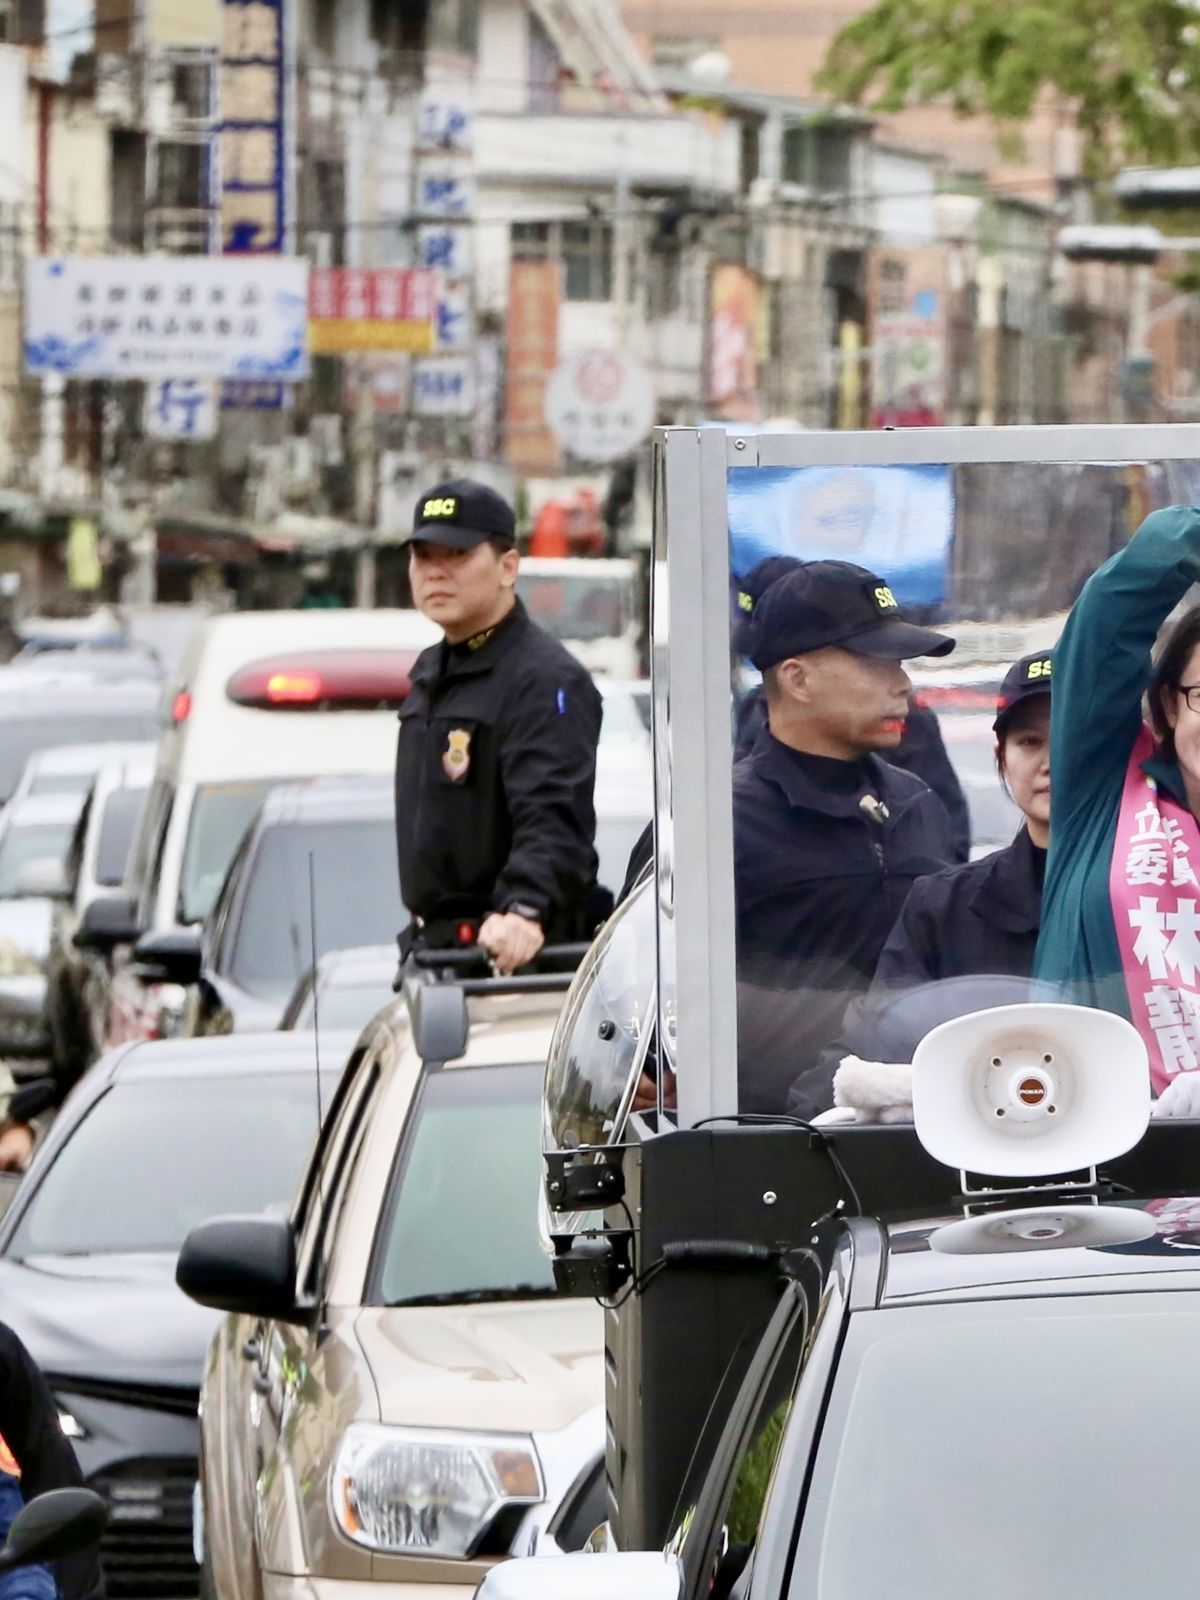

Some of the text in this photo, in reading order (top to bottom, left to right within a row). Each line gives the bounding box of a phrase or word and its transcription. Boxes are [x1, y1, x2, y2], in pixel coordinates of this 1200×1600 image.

[423, 498, 456, 517] SSC
[874, 586, 899, 608] SS
[1027, 659, 1052, 679] SS
